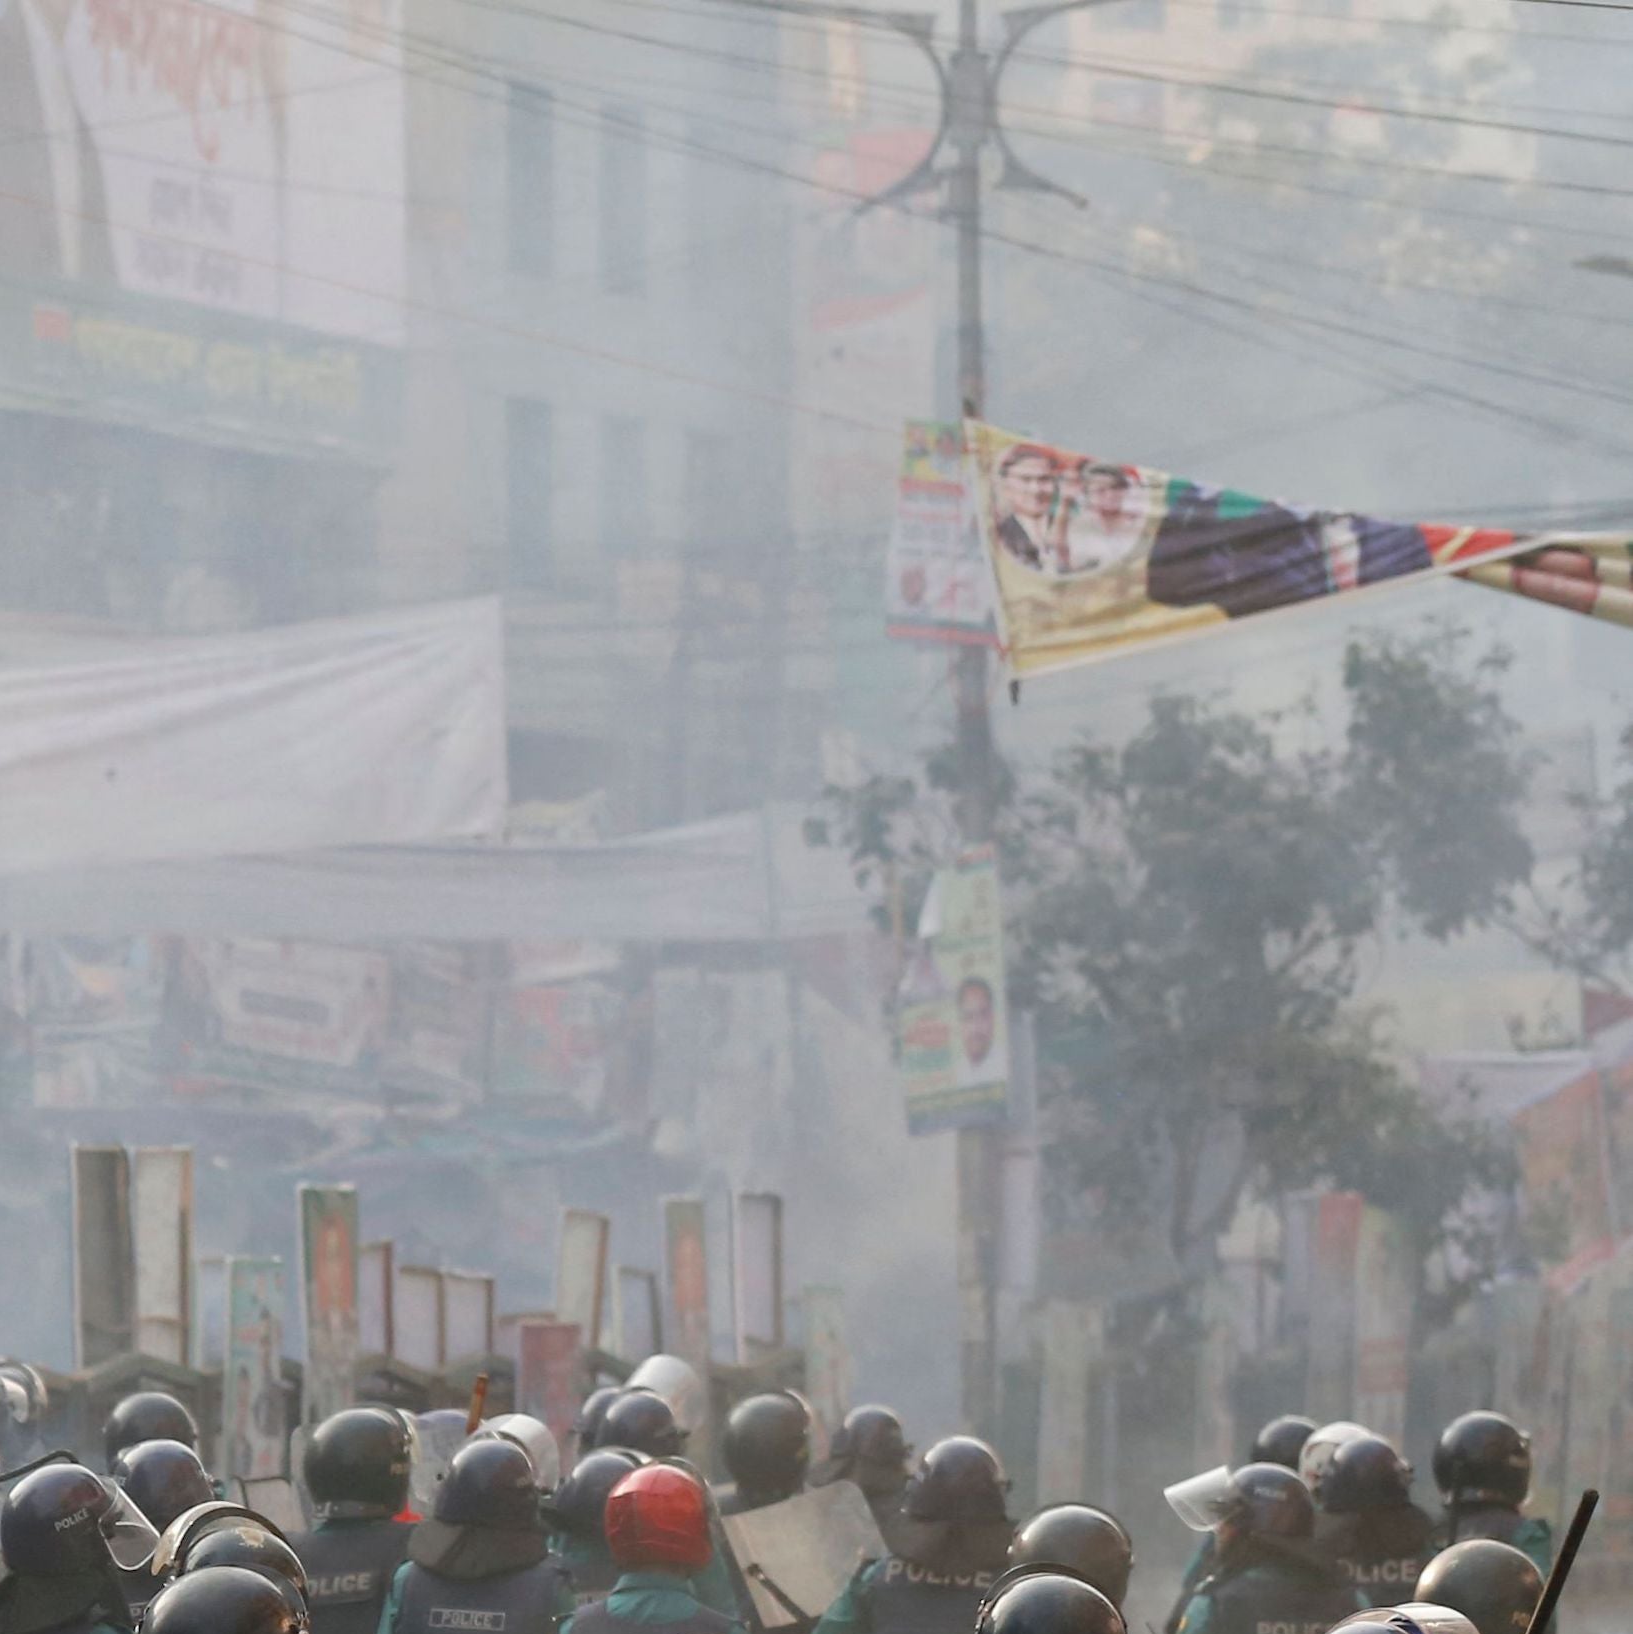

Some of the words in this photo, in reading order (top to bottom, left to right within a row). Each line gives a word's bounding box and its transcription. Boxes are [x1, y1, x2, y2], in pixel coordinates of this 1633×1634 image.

[53, 1509, 90, 1533] POLICE
[307, 1572, 373, 1598] OLICE
[440, 1610, 495, 1628] POLICE
